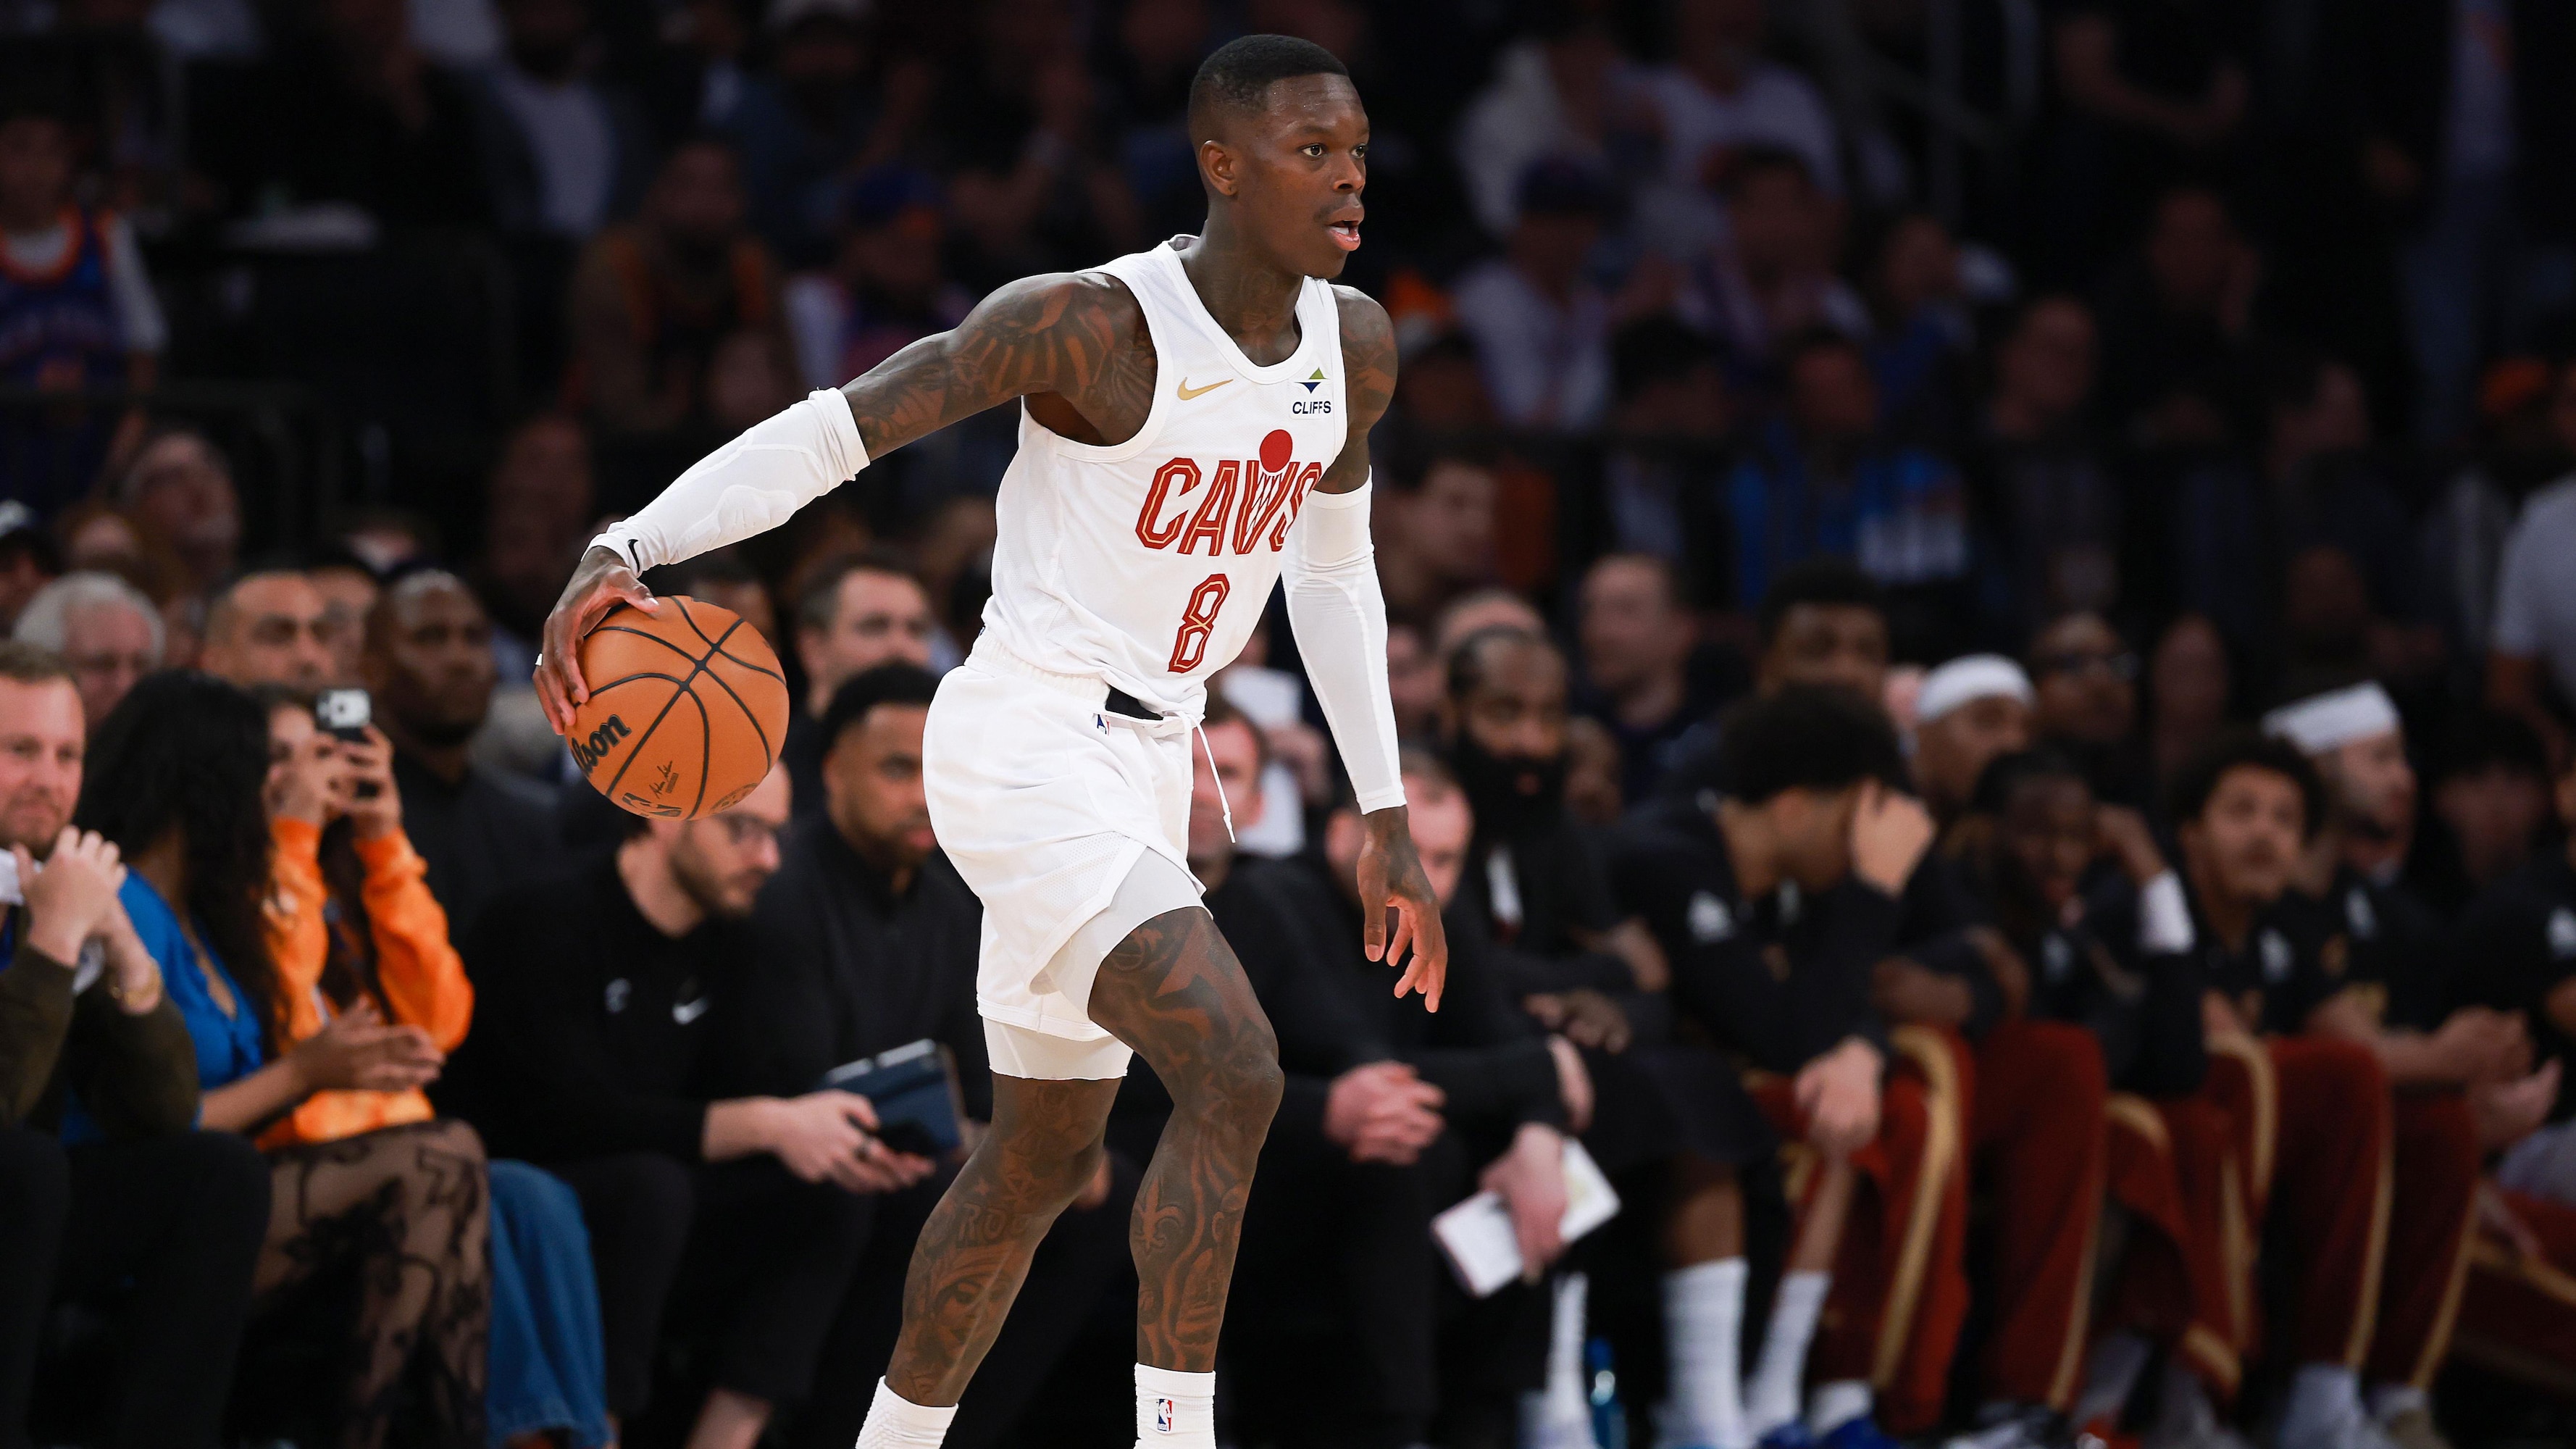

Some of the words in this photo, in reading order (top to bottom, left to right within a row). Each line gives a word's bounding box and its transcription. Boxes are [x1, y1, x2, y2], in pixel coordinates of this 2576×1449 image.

[1292, 401, 1331, 414] CLIFFS
[1168, 574, 1230, 673] 8
[571, 714, 632, 777] lson
